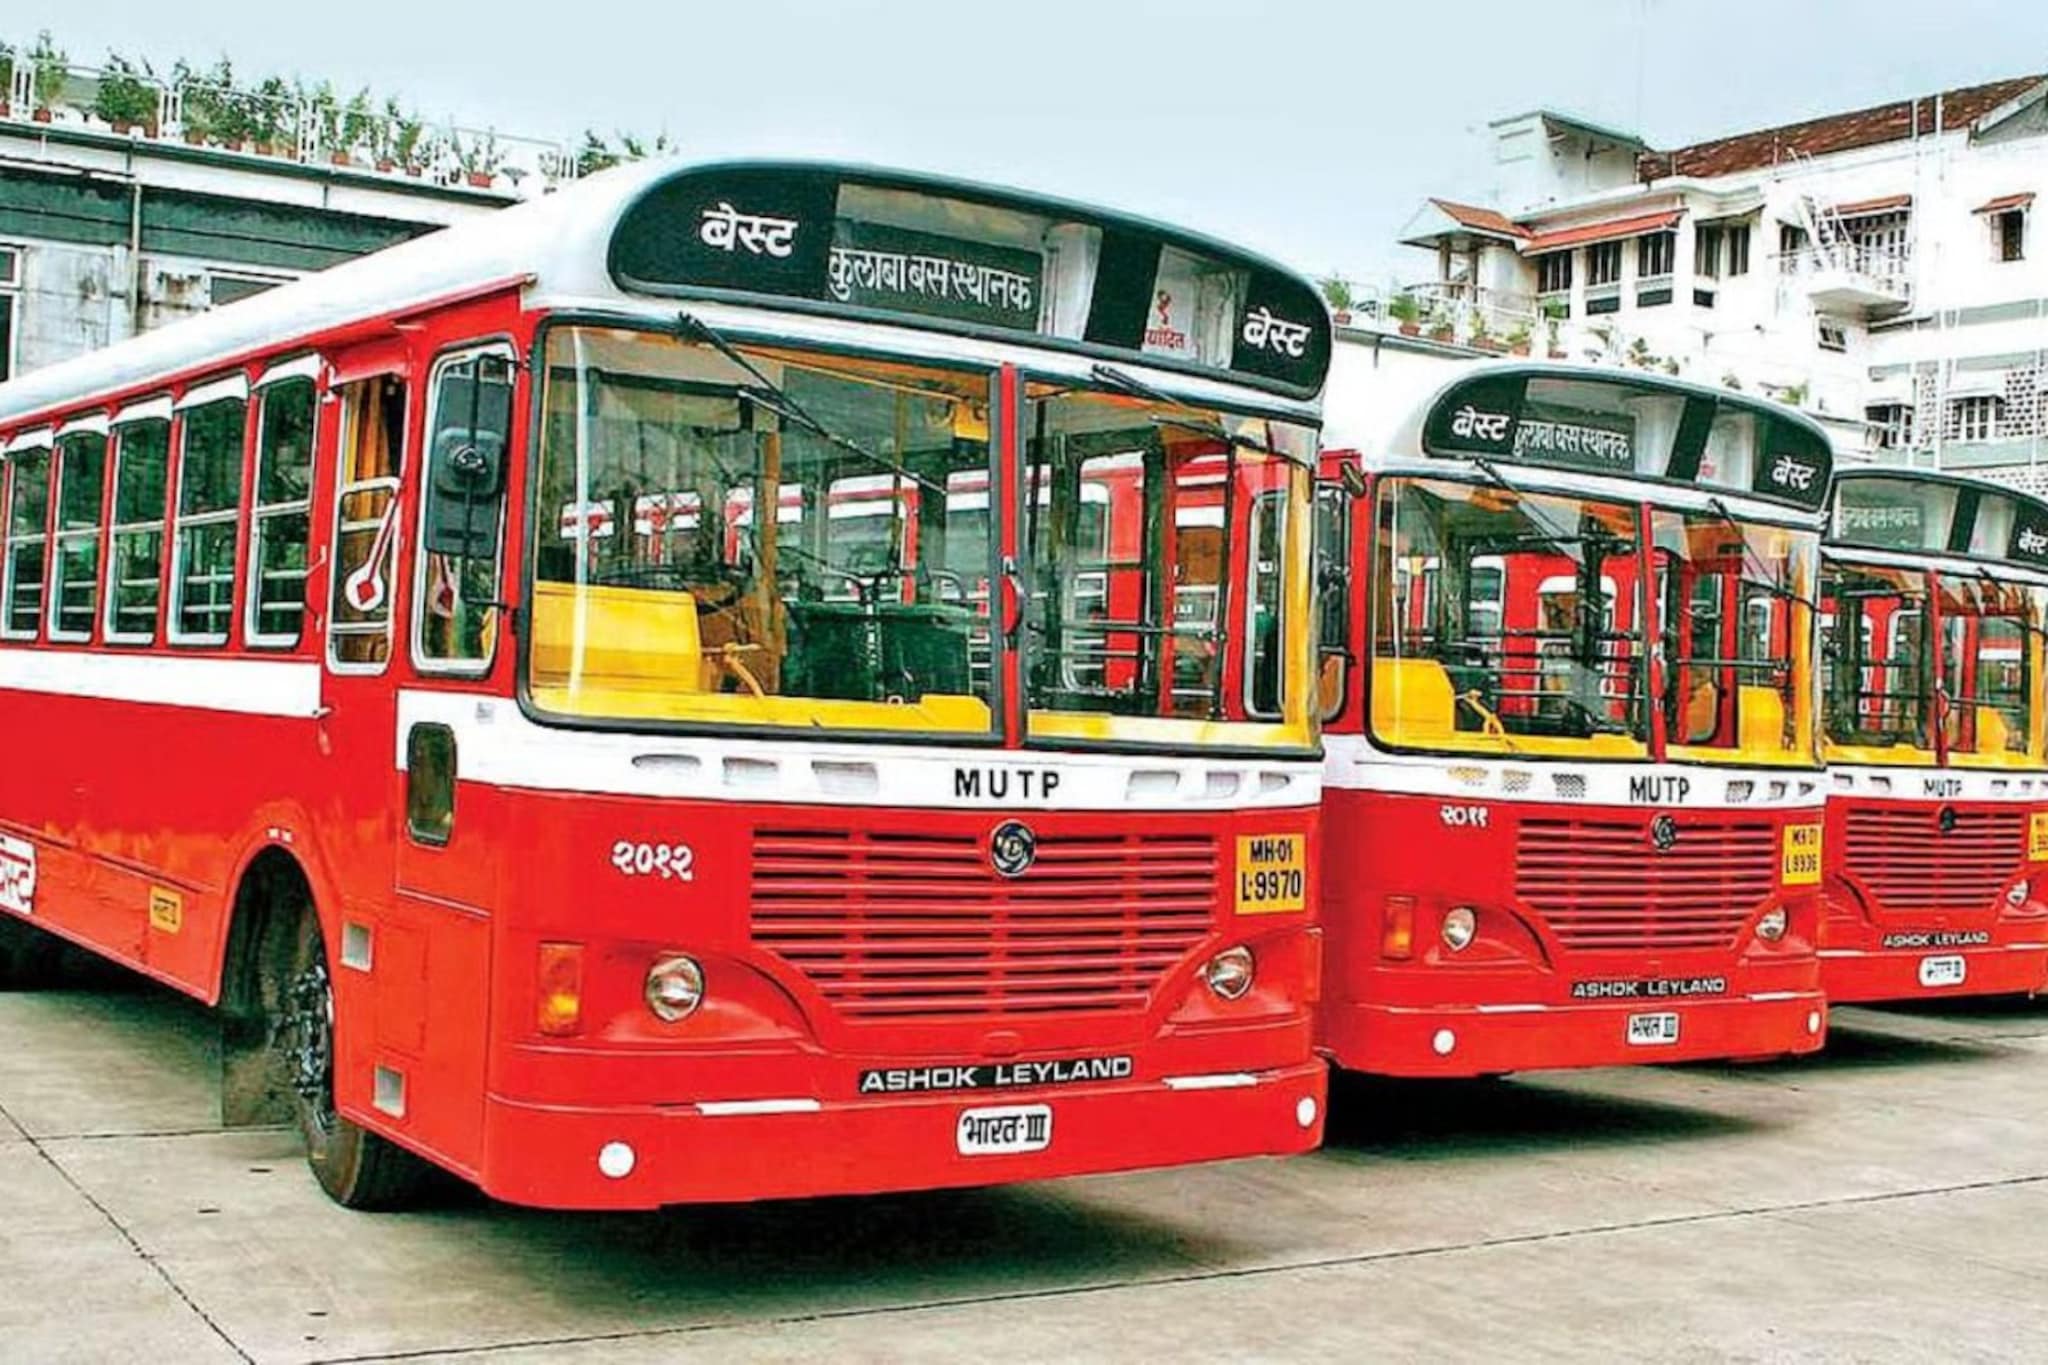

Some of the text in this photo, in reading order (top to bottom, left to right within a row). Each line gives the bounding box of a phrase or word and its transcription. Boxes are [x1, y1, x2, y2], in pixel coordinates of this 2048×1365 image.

[701, 202, 798, 257] बेस्ट
[828, 246, 1032, 311] कुलाबा बस स्थानक
[1243, 306, 1311, 357] बेस्ट
[1452, 405, 1510, 441] बेस्ट
[1772, 455, 1817, 490] बेस्ट
[955, 767, 1060, 798] MUTP
[1629, 775, 1691, 803] MUTP
[611, 840, 694, 882] २०१२
[1573, 978, 1726, 997] ASHOK LEYLAND
[860, 1056, 1133, 1092] ASHOK LEYLAND
